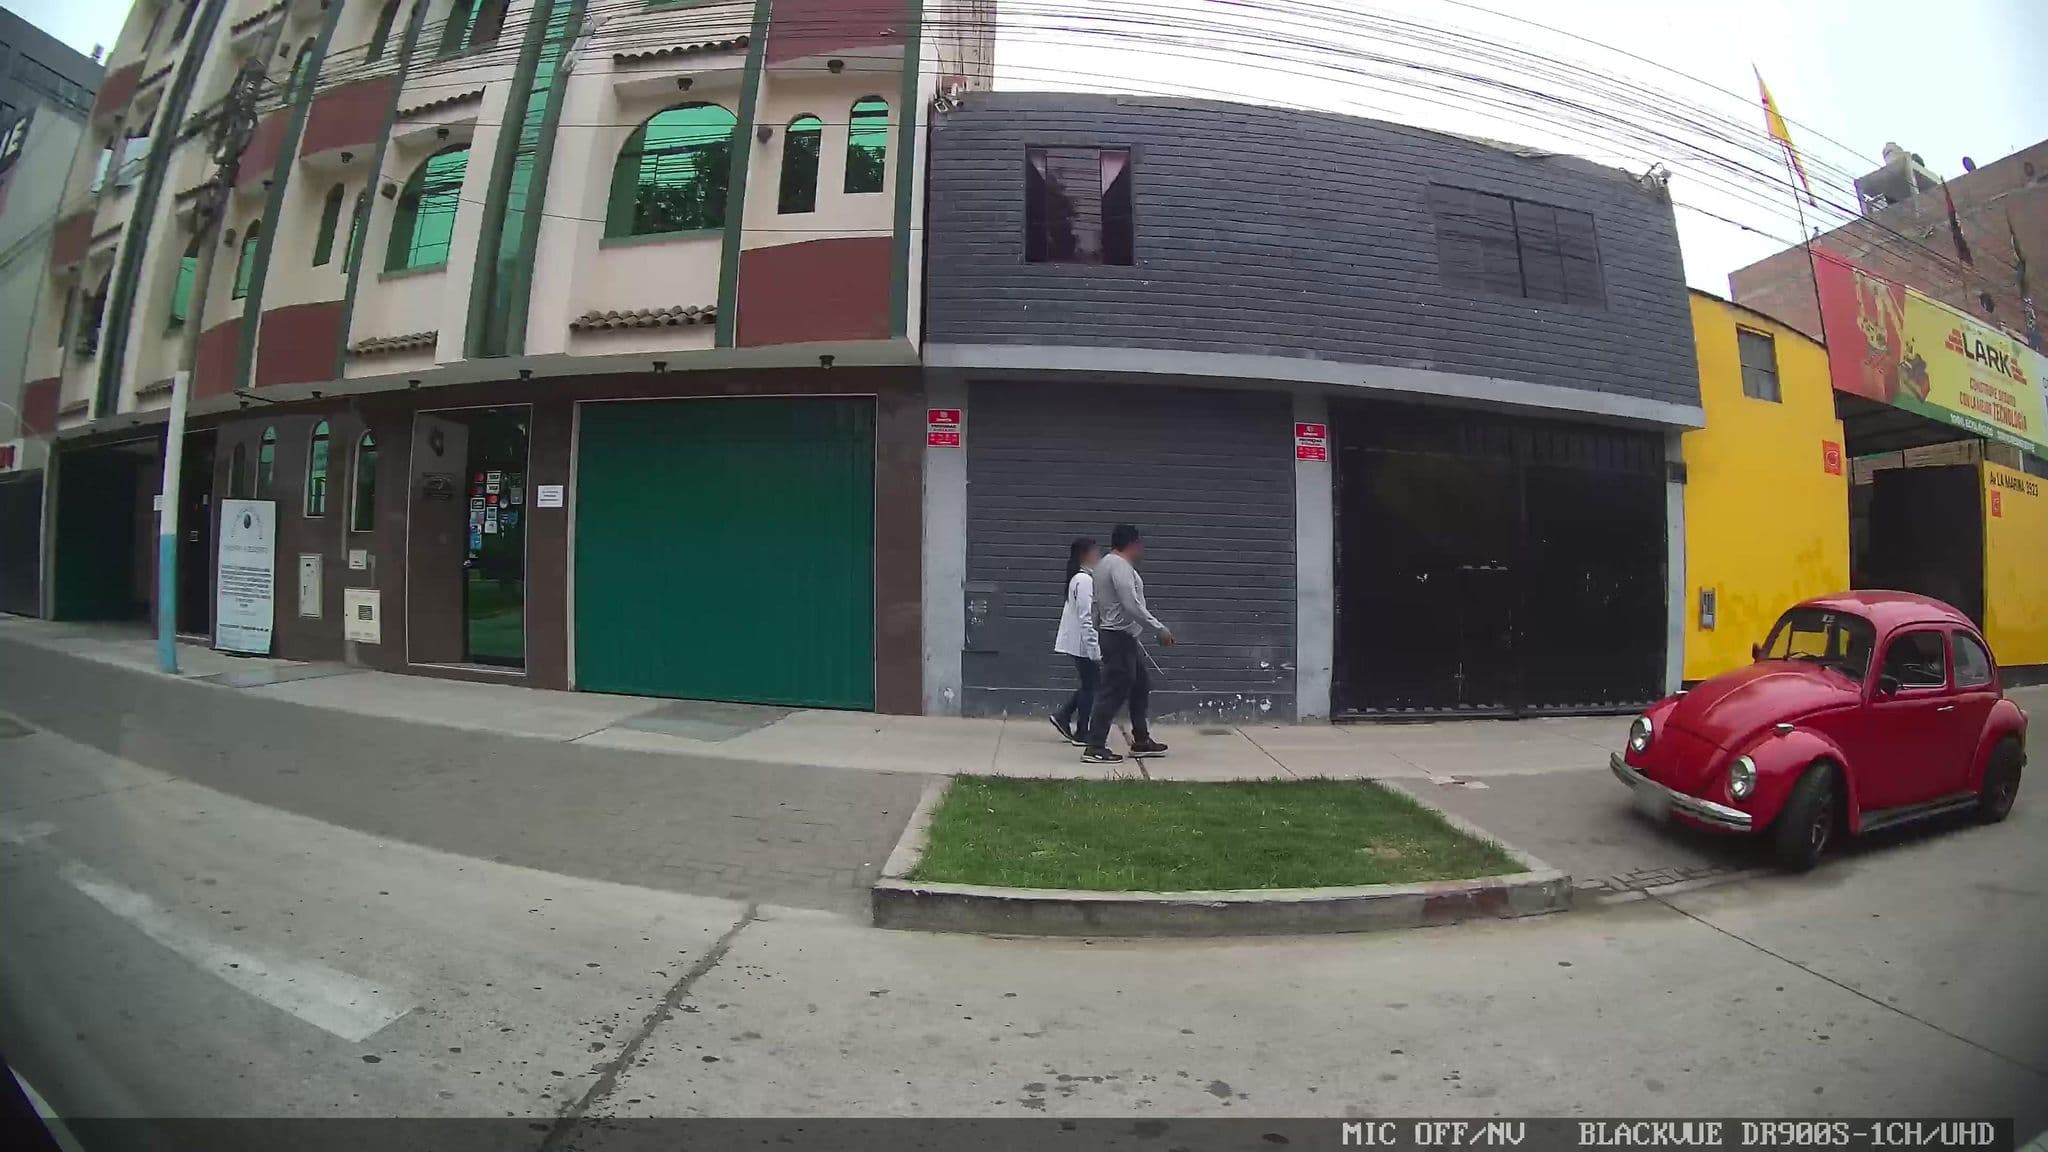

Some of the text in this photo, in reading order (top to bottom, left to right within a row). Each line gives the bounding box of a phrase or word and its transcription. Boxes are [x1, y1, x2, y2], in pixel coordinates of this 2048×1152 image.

[1962, 332, 2012, 378] LARK
[1997, 472, 2005, 487] LA
[2005, 474, 2025, 492] MARINA
